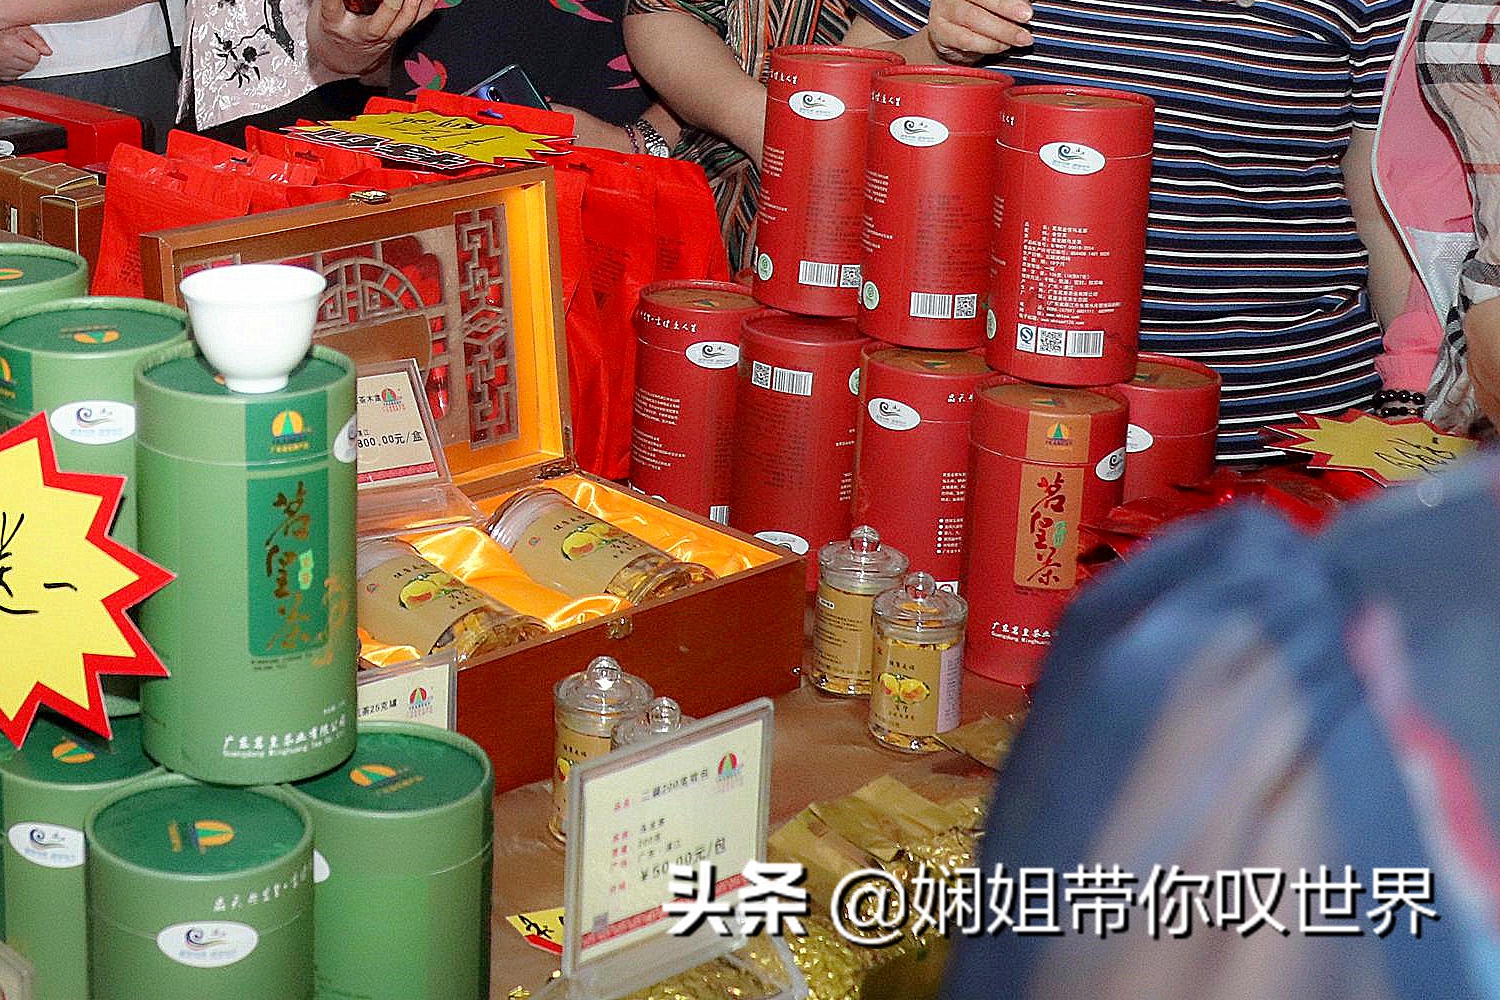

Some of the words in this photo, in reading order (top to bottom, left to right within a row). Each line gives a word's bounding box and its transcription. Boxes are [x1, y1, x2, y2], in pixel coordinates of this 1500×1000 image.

[264, 480, 312, 650] 茗皇茶
[1026, 471, 1067, 586] 茗皇茶
[639, 837, 727, 883] ¥5000元/包
